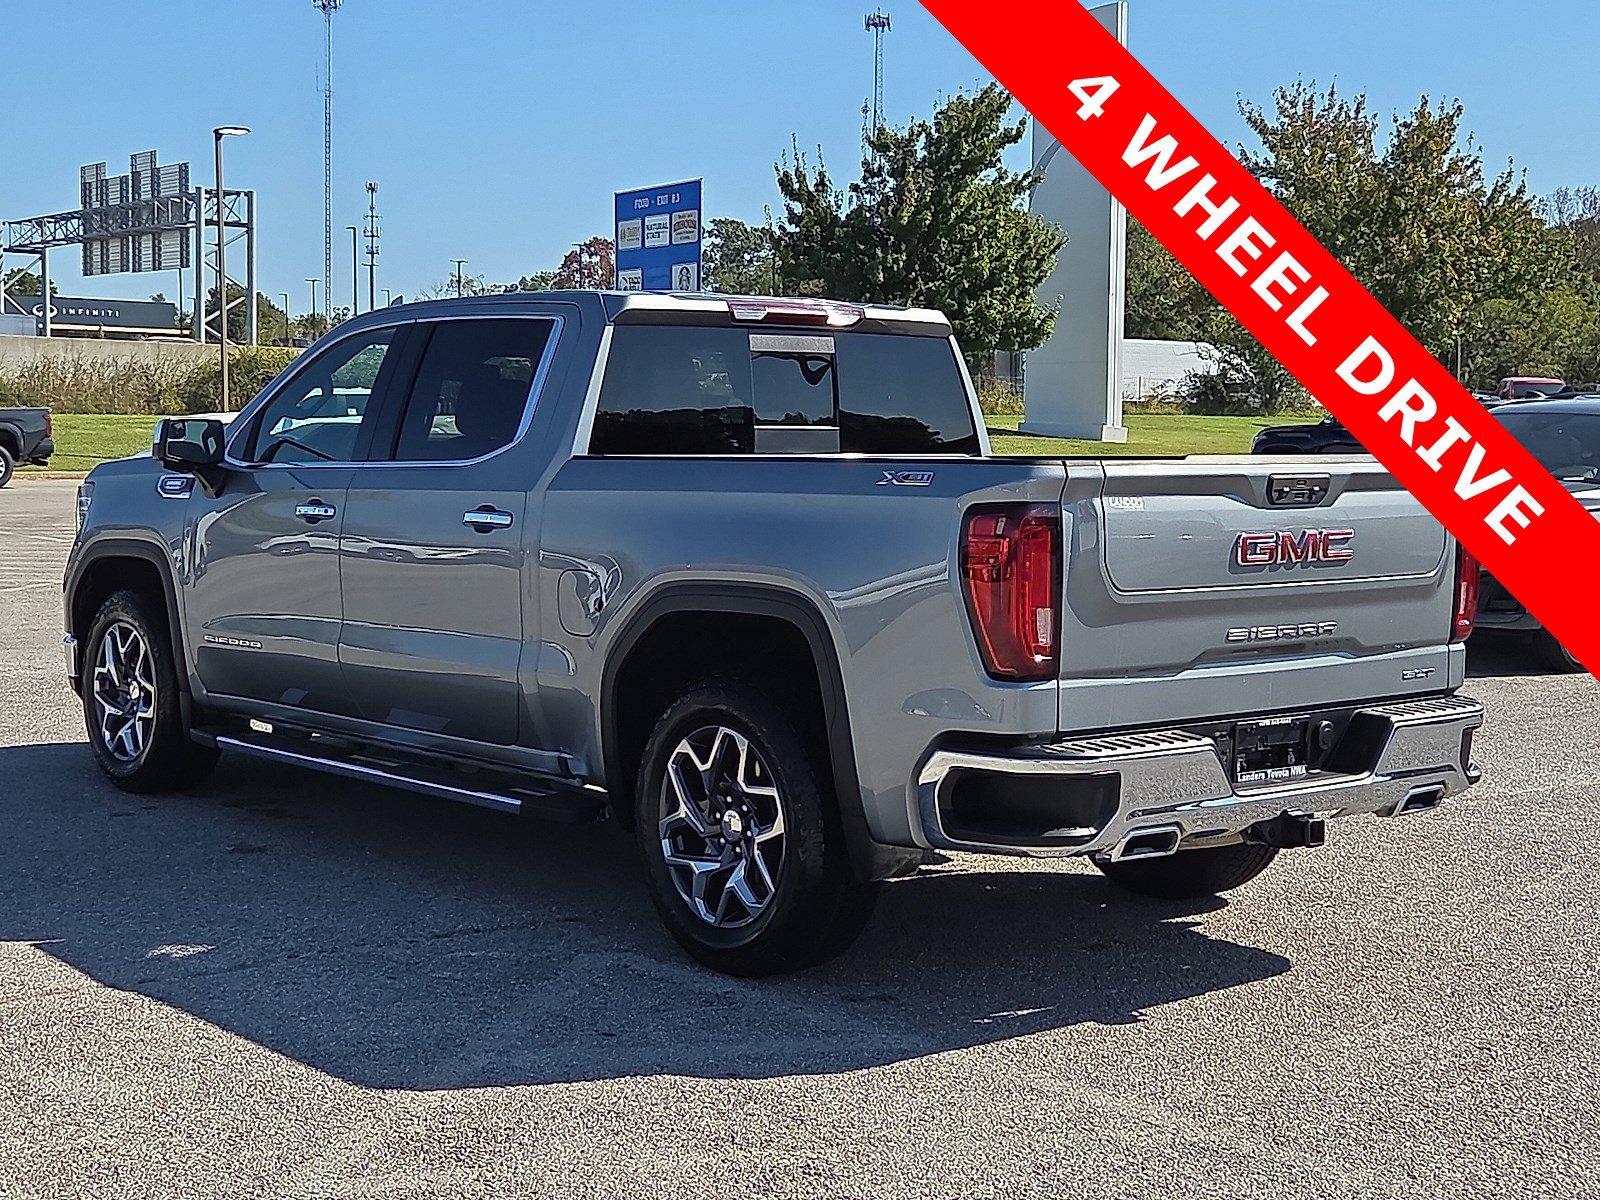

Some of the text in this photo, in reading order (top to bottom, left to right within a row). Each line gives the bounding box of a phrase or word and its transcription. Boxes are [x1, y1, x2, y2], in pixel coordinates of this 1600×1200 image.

[645, 221, 669, 231] NATURAL
[645, 231, 661, 240] STATE
[61, 307, 121, 318] INFINITI
[1237, 528, 1355, 566] GMC
[1226, 620, 1338, 641] SIERRA
[1237, 764, 1307, 783] Landers Toyota NWA
